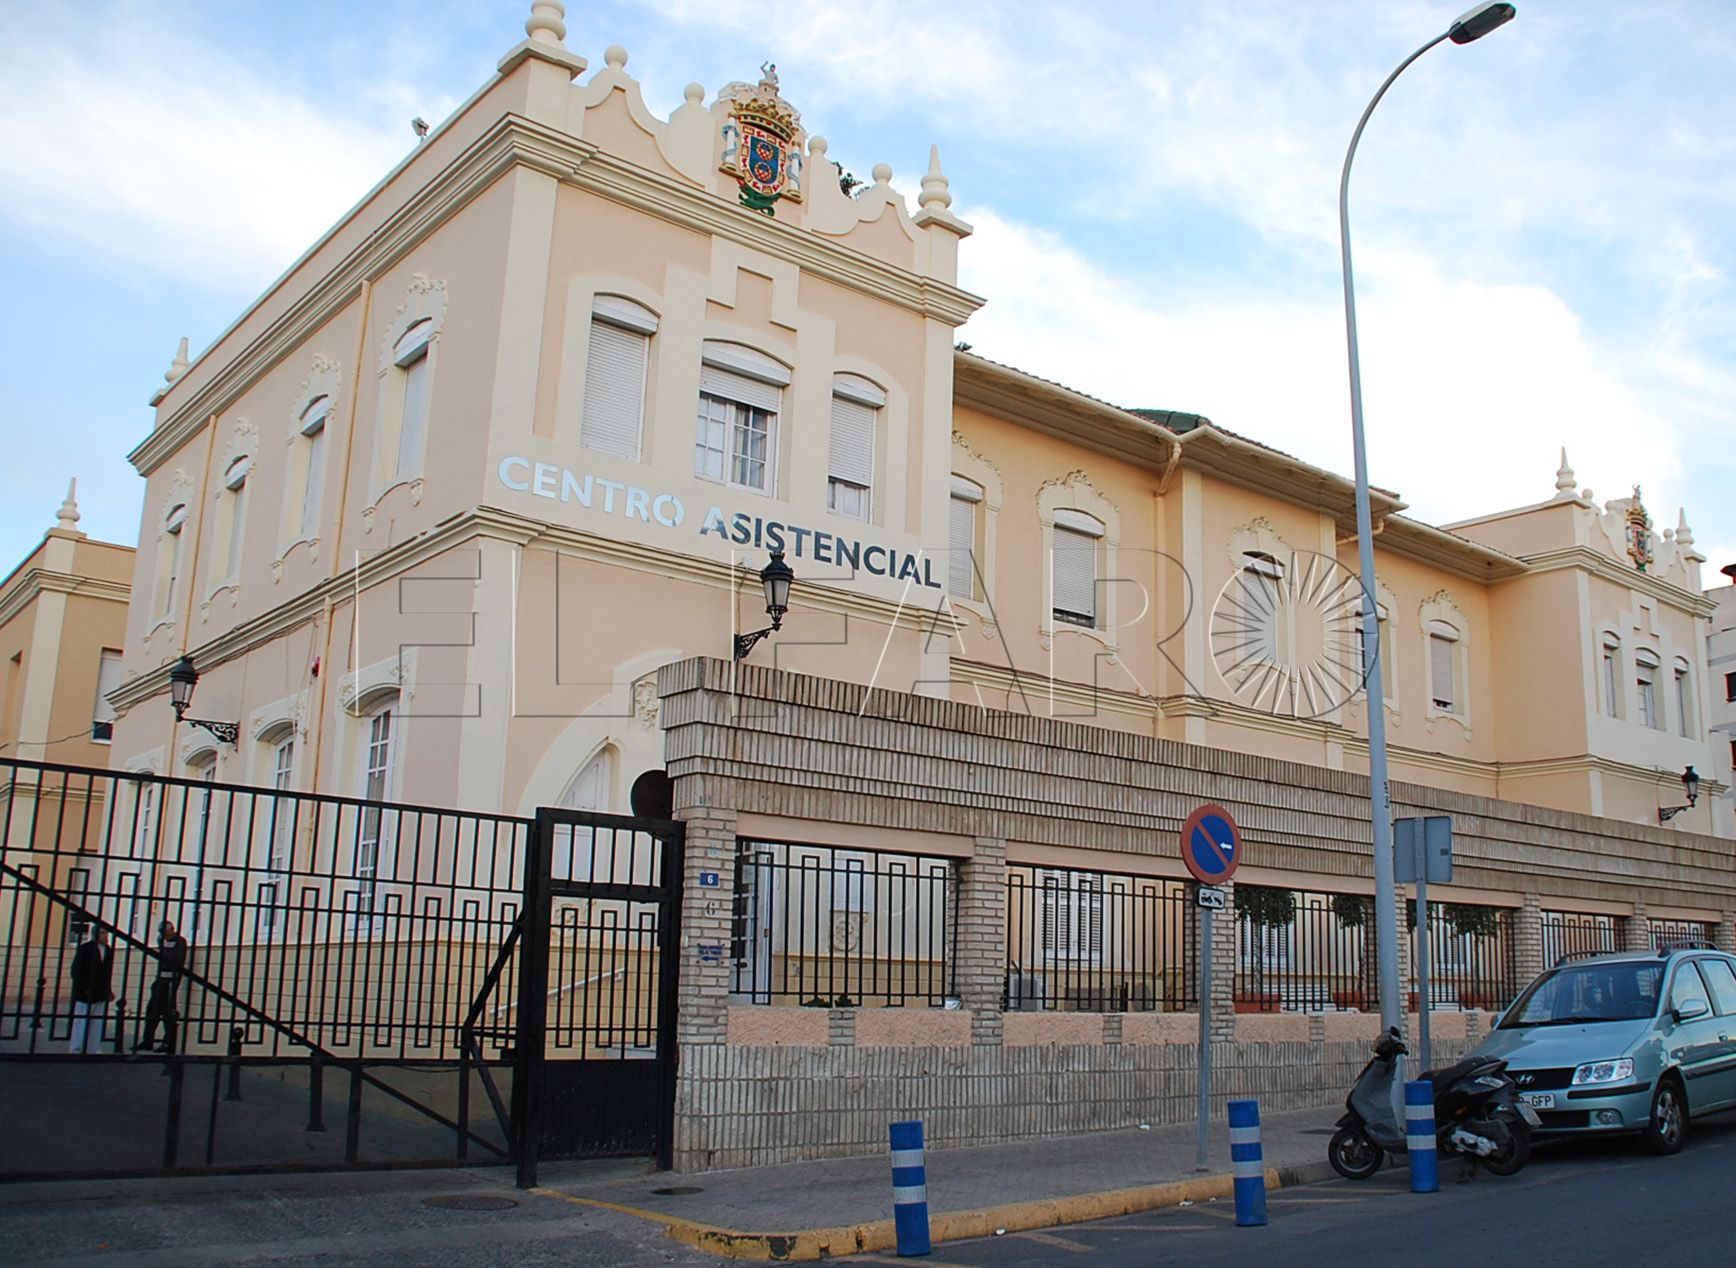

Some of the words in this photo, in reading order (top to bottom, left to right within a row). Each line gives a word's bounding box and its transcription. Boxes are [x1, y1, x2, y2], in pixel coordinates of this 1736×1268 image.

[498, 455, 686, 527] CENTRO
[699, 505, 942, 589] ASISTENCIAL
[707, 875, 714, 884] 6
[706, 900, 717, 916] 6
[1531, 1095, 1552, 1107] GFP
